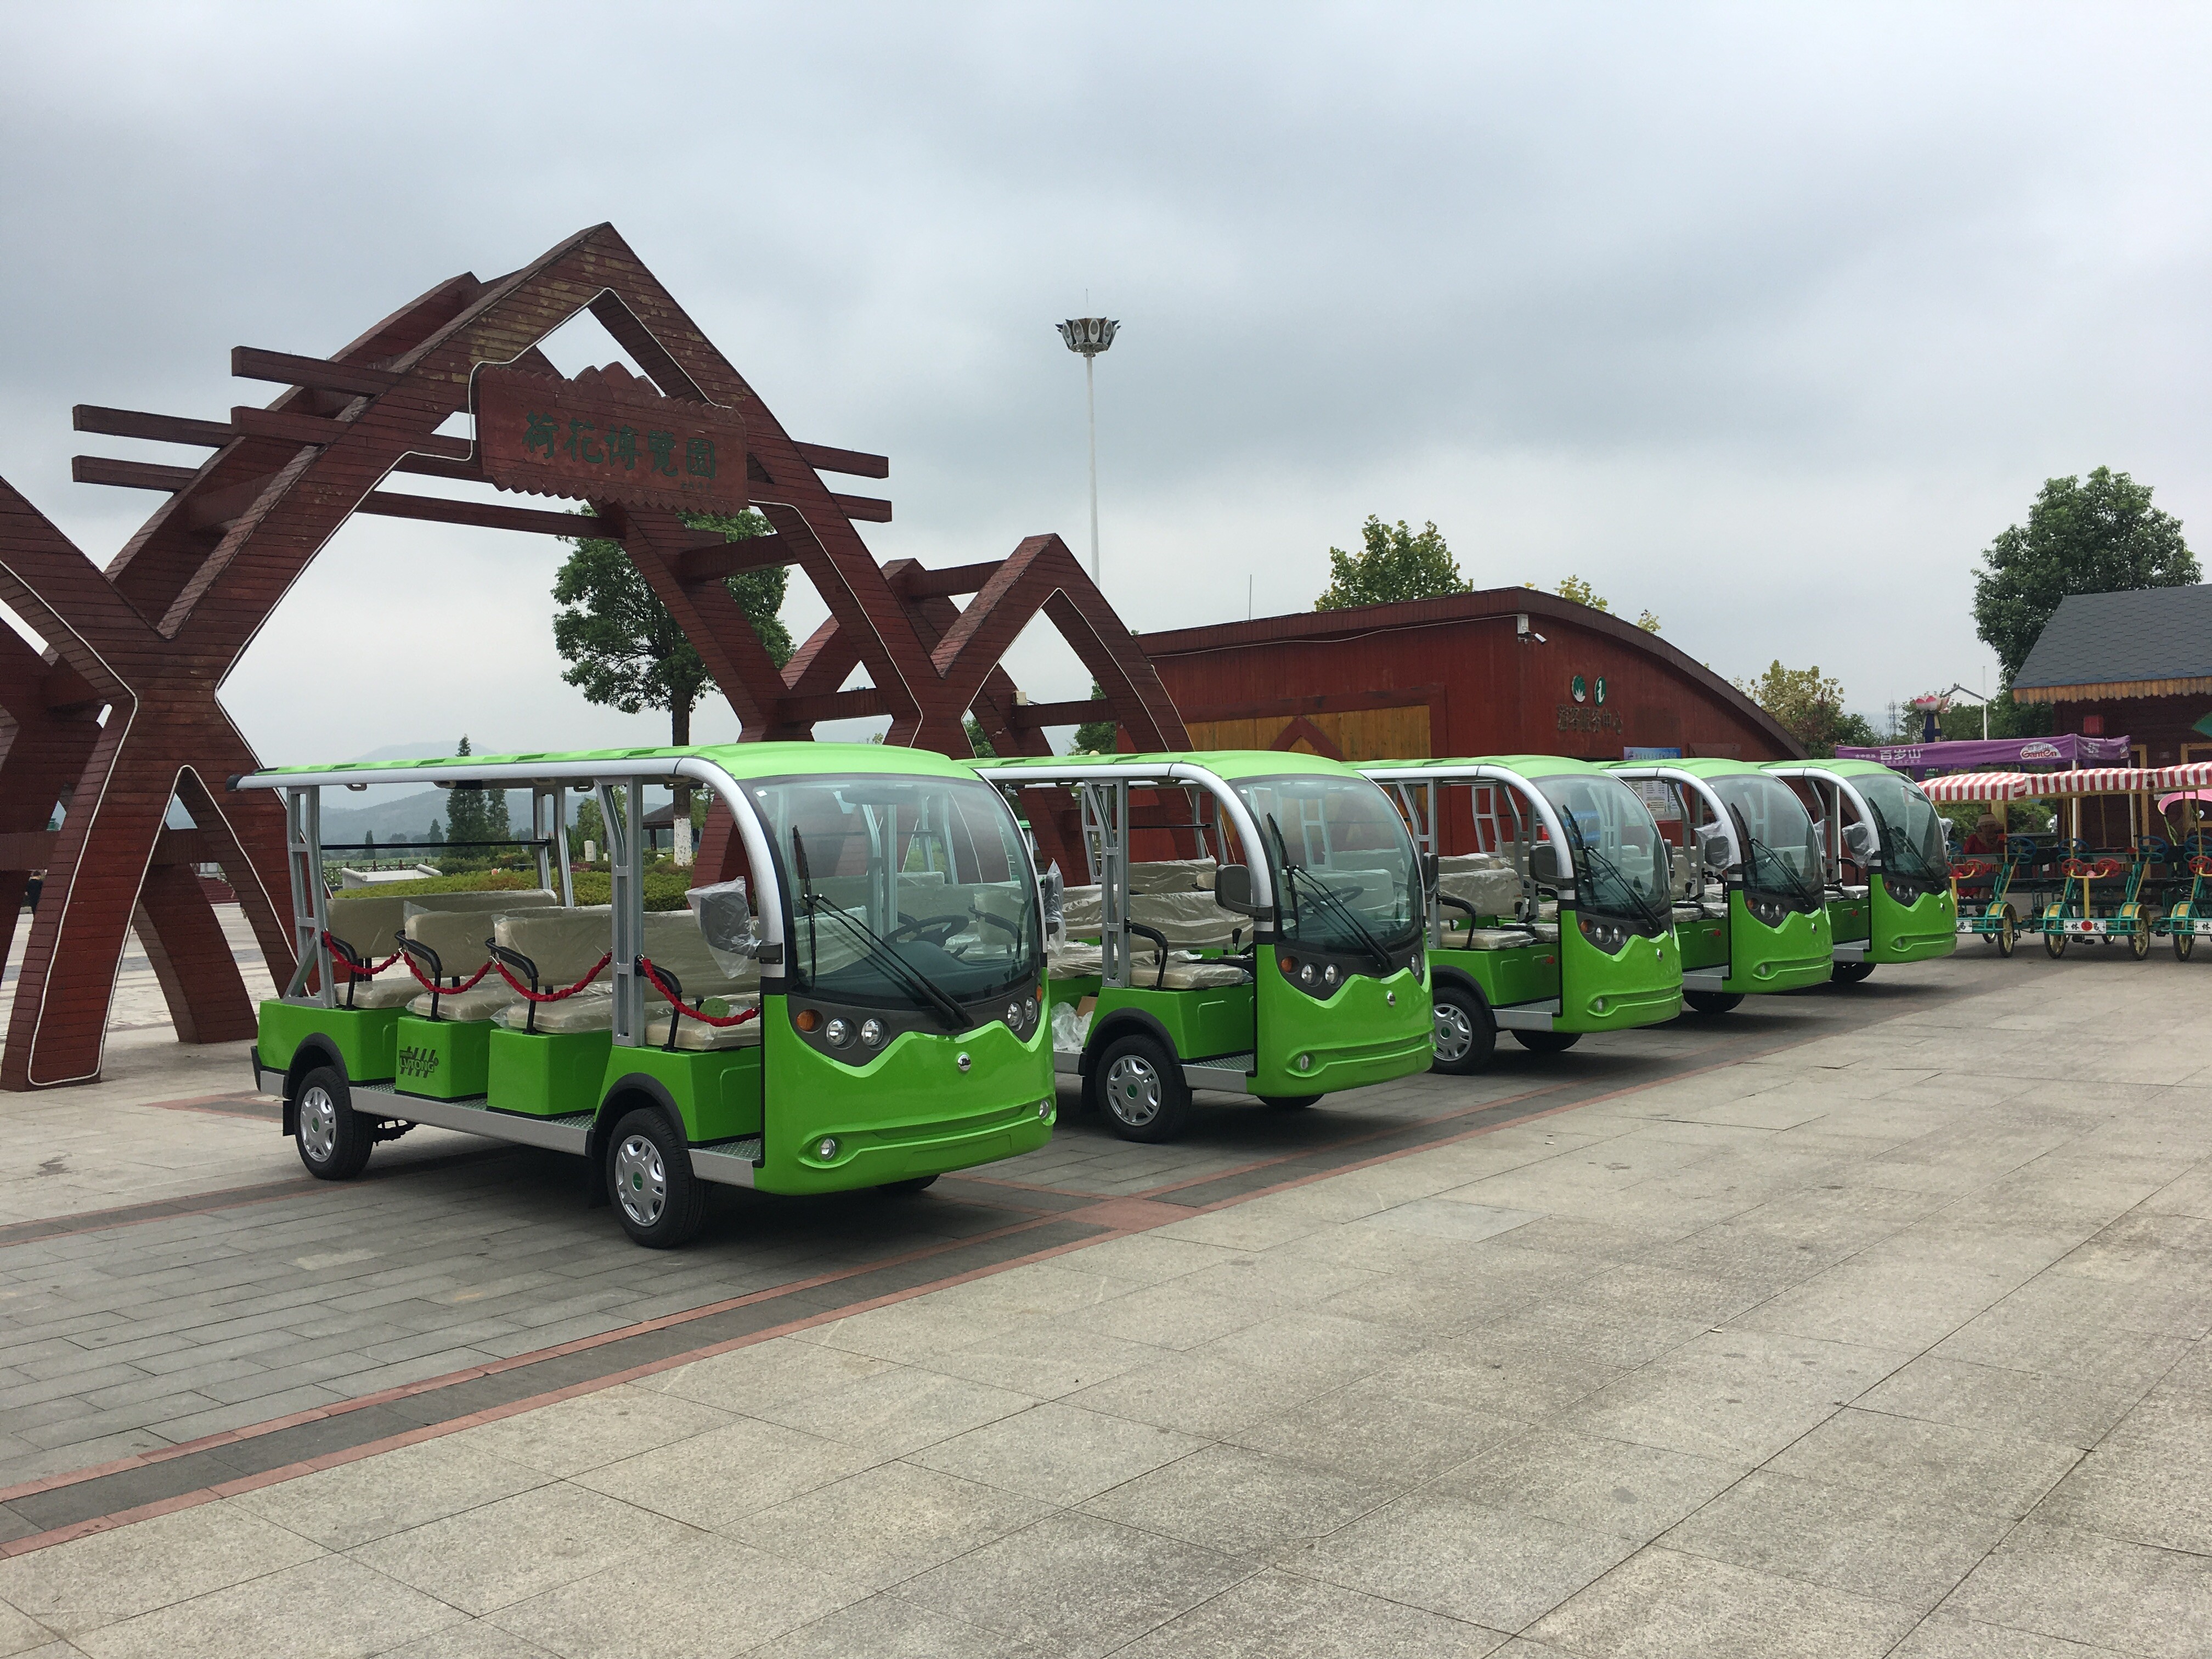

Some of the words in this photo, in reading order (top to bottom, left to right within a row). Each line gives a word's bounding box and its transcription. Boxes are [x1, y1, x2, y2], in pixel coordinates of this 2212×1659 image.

[1880, 749, 1921, 760] 百岁山
[399, 1058, 435, 1073] LVTONG
